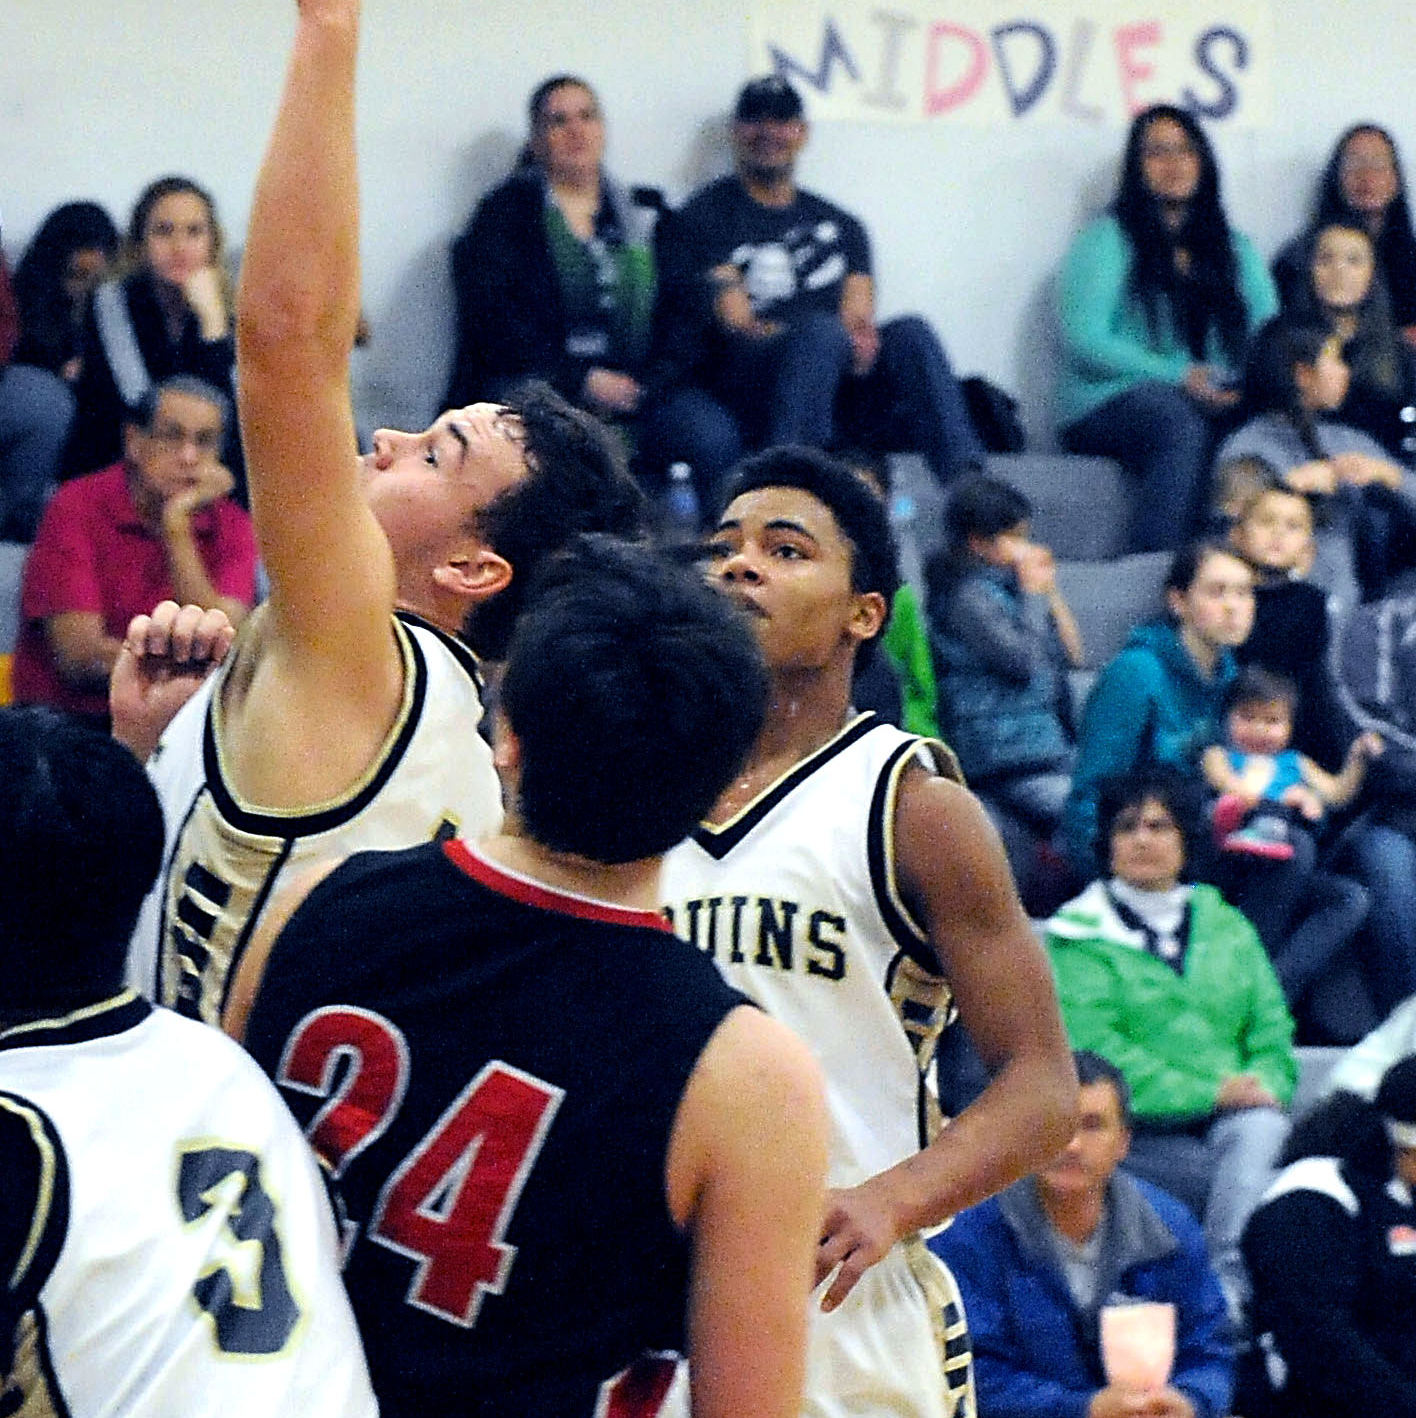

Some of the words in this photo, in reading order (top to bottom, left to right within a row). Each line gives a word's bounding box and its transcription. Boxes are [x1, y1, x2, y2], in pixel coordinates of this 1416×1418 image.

[767, 9, 1249, 122] MIDDLES
[661, 895, 846, 982] UINS
[174, 1136, 306, 1364] 3
[277, 1004, 566, 1329] 24
